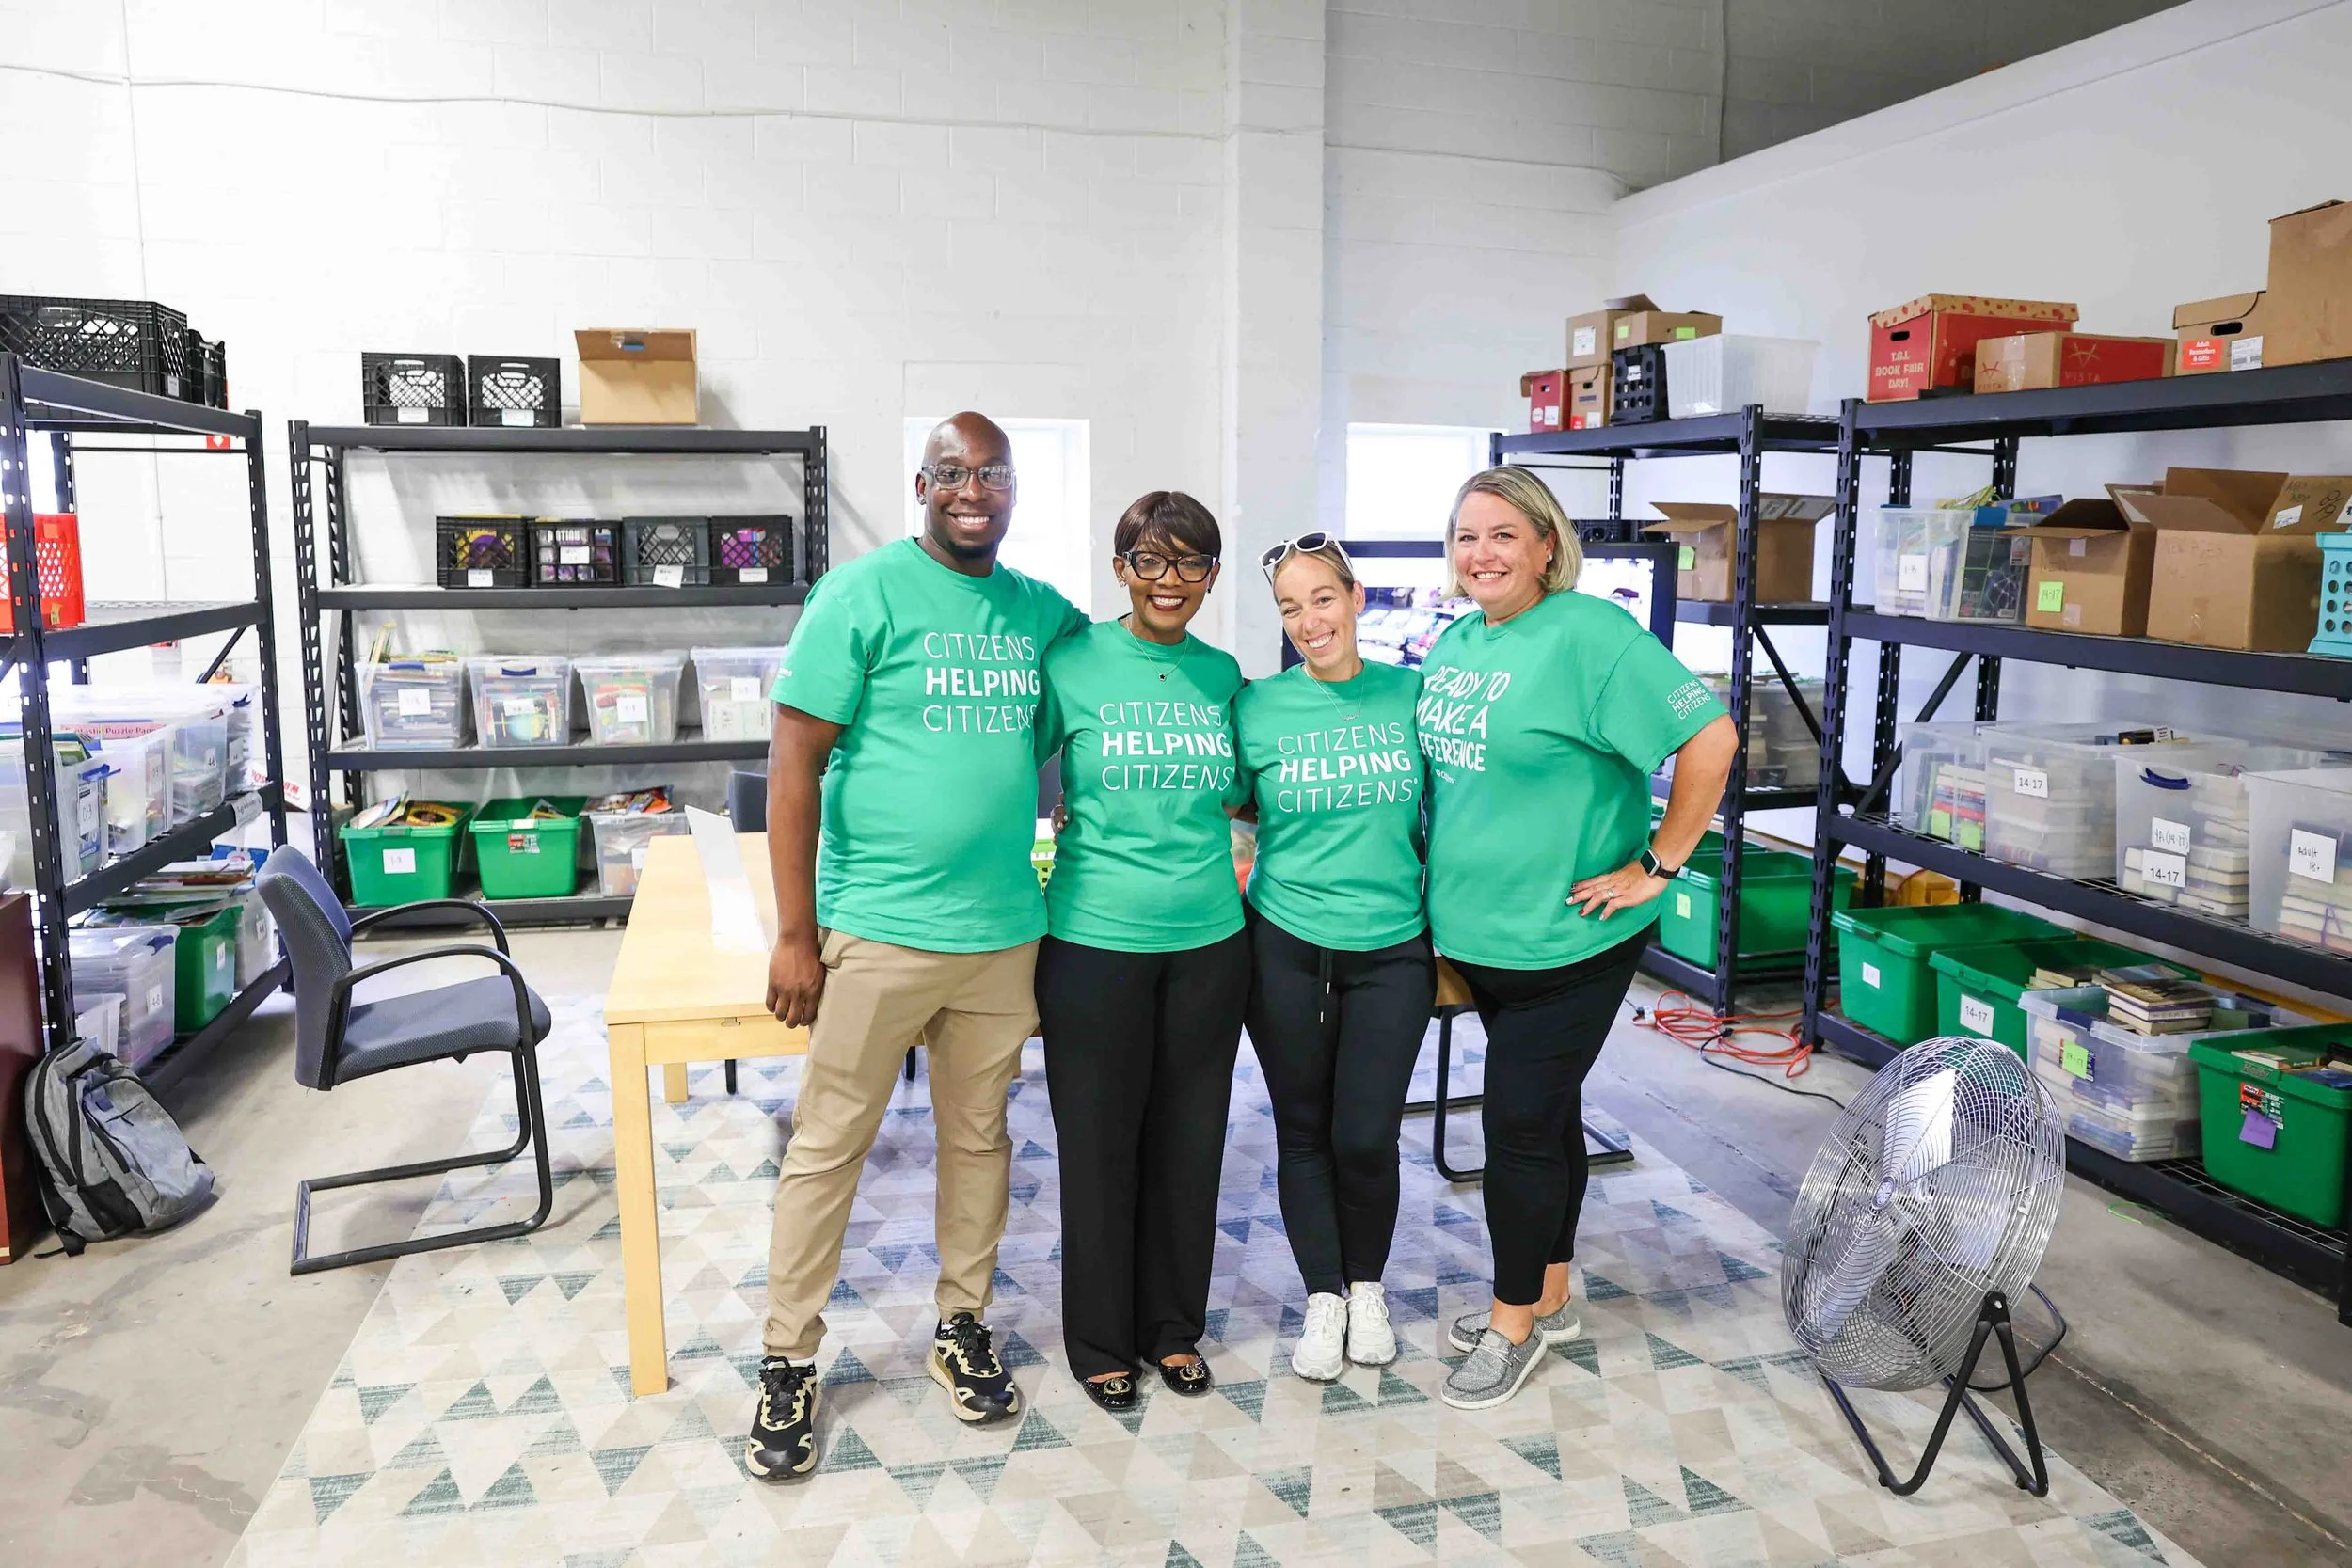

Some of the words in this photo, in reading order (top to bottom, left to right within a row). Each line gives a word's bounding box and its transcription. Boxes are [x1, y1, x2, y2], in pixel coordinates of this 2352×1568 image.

[1875, 364, 1901, 376] BOOK
[1903, 362, 1925, 374] FAIR
[2064, 371, 2102, 383] VISTA
[1888, 377, 1909, 389] DAY!
[923, 631, 1035, 661] CITIZENS
[925, 666, 1041, 697] HELPING
[1480, 671, 1512, 702] TO
[1667, 679, 1700, 704] CITIZENS
[1672, 687, 1706, 713] HELPING
[1678, 692, 1712, 720] CITIZENS
[1099, 701, 1222, 727] CITIZENS
[1468, 705, 1489, 740] A
[1102, 731, 1232, 758] HELPING
[1278, 721, 1406, 755] CITIZENS
[1417, 730, 1487, 772] FFERENCE
[1279, 749, 1412, 784] HELPING
[2018, 777, 2043, 790] 14-17
[2297, 846, 2319, 858] Adult
[2150, 866, 2180, 883] 14-17
[1964, 1006, 1988, 1023] 14-17
